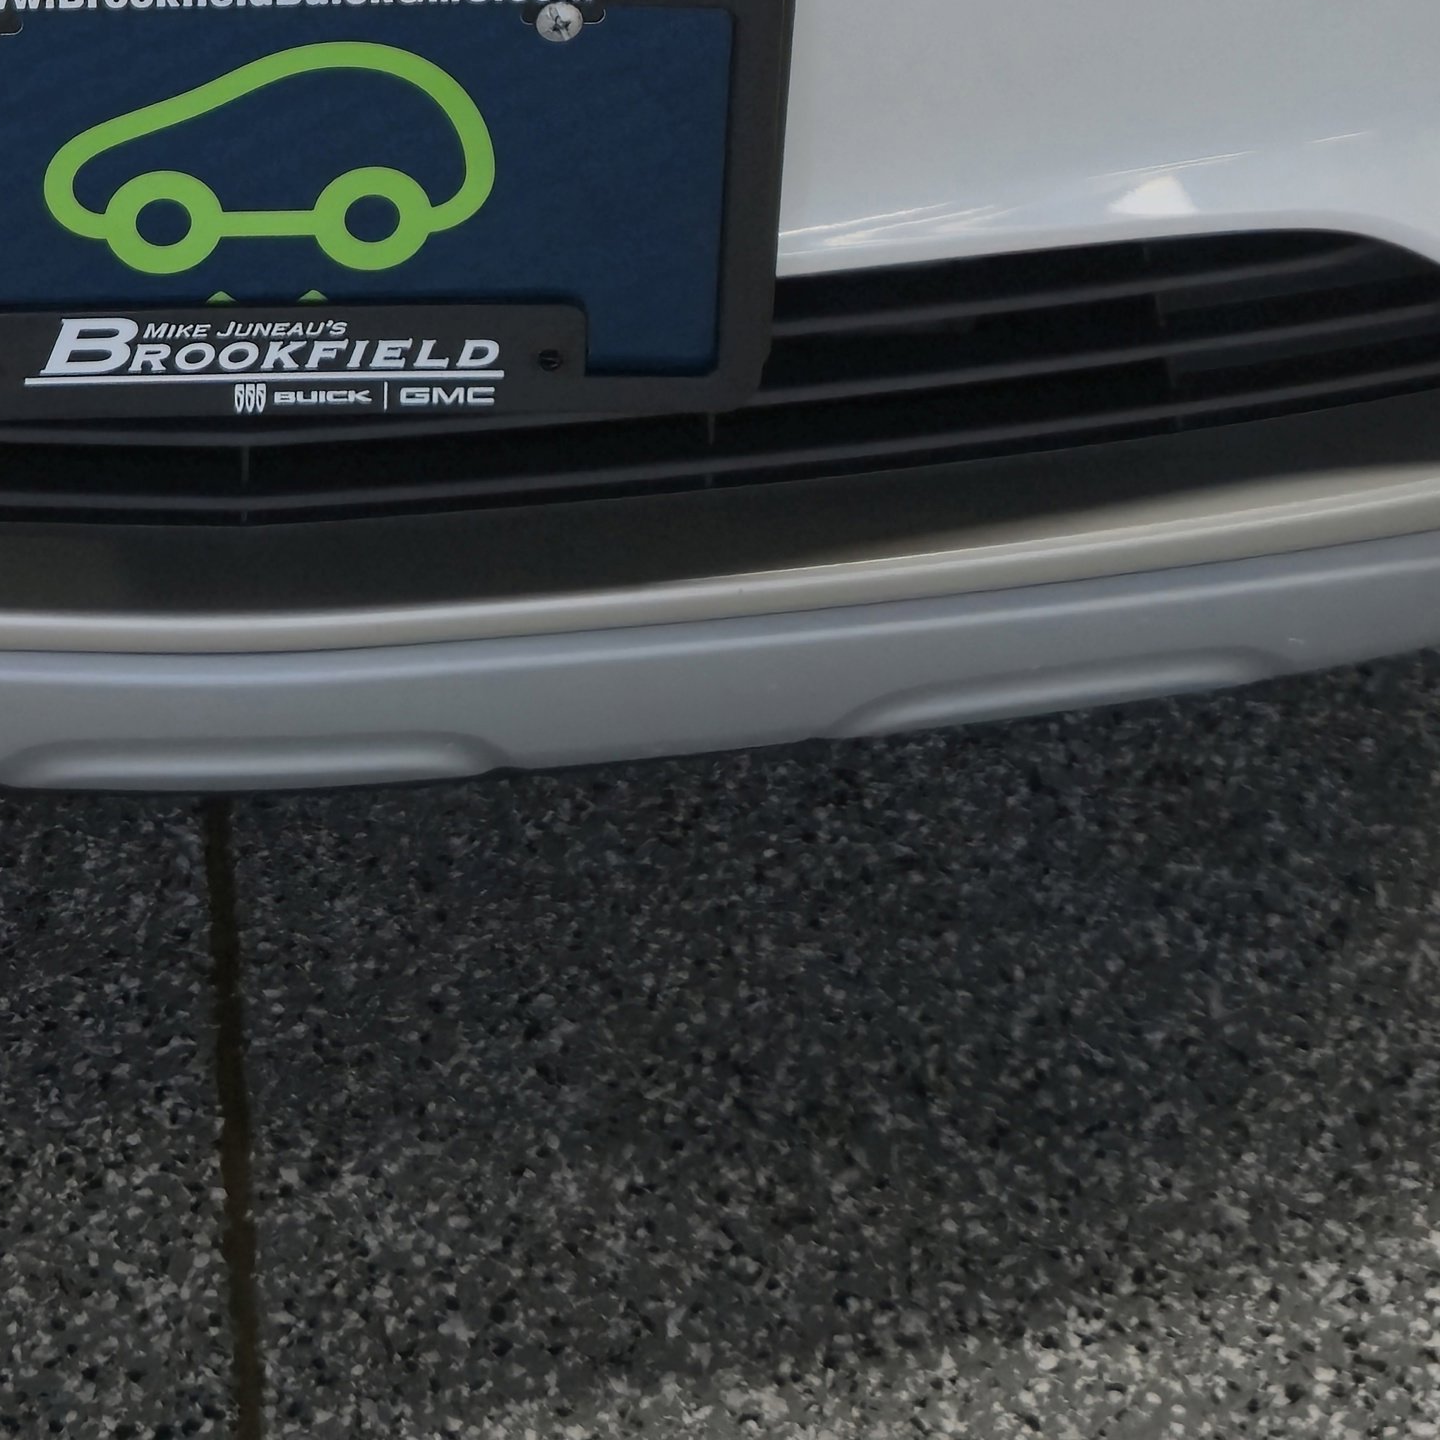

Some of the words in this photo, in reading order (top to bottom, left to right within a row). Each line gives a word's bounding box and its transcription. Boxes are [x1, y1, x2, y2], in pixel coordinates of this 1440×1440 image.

[142, 322, 211, 338] MIKE
[216, 319, 348, 338] JUNEAU'S
[39, 317, 501, 376] BROOKFIELD
[272, 387, 372, 405] BUICK
[398, 385, 496, 406] GMC
